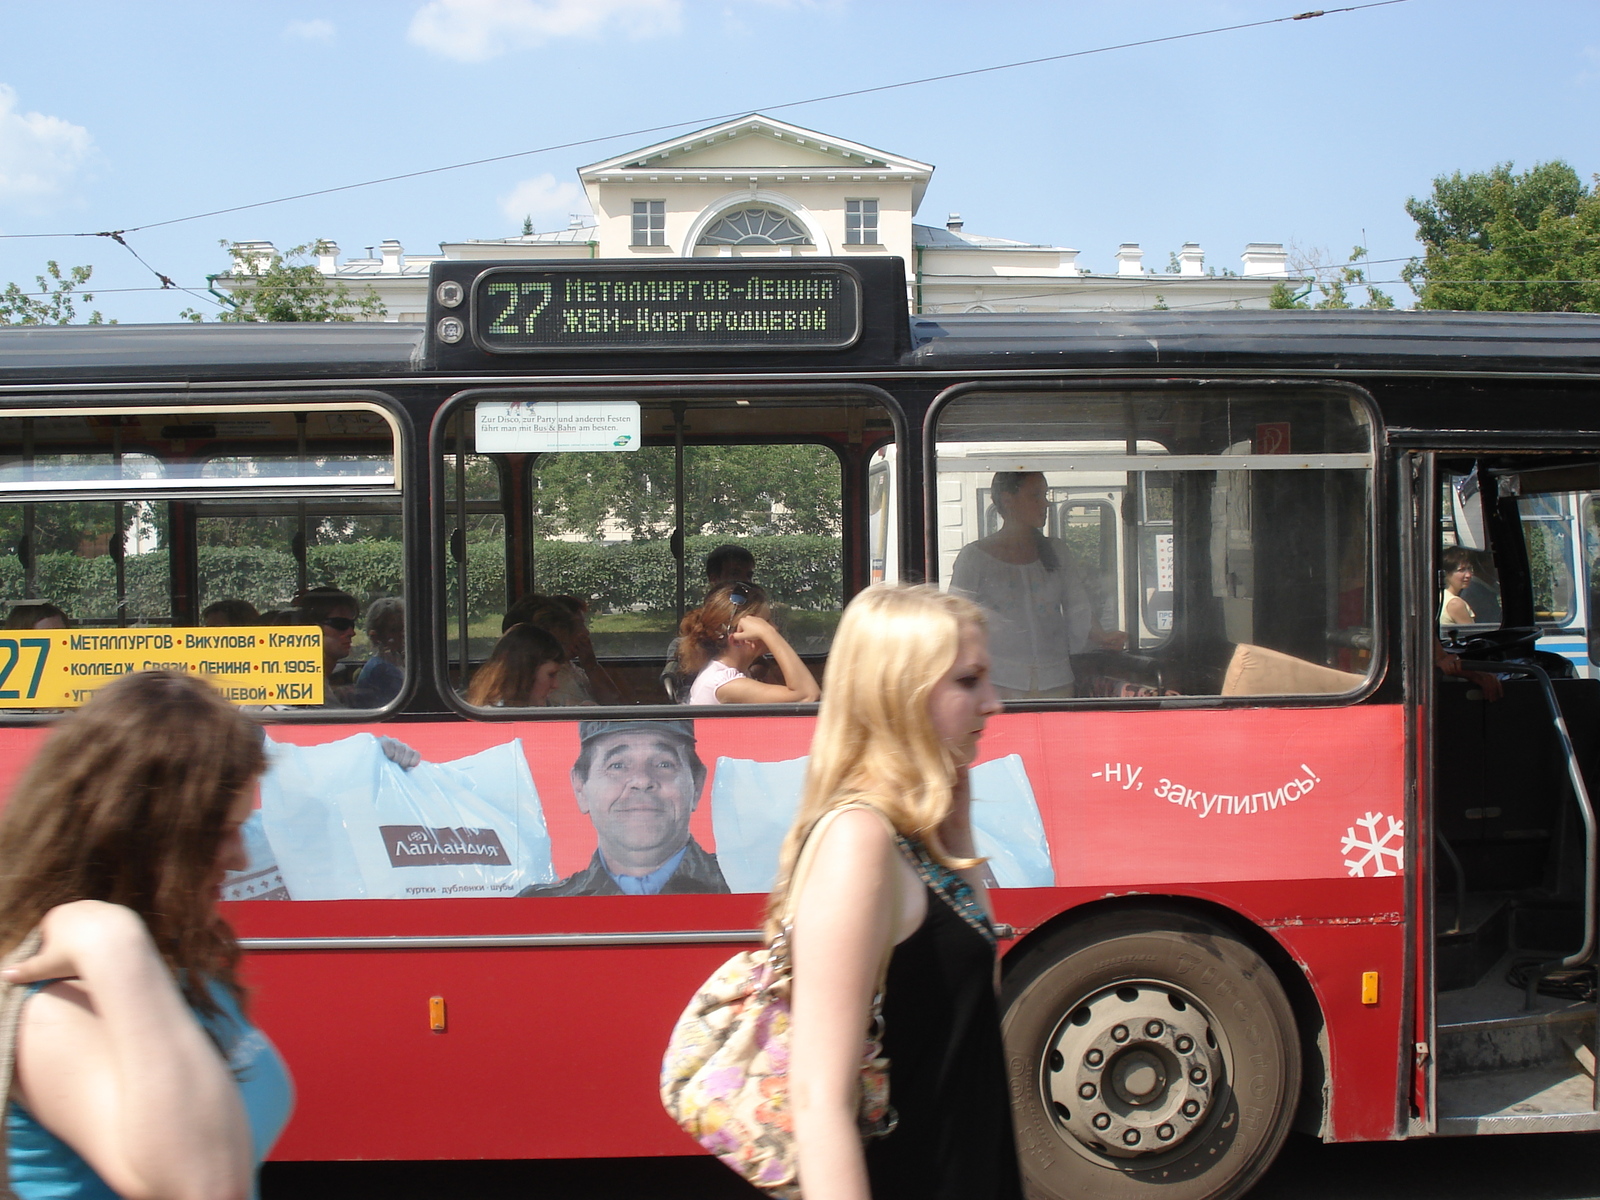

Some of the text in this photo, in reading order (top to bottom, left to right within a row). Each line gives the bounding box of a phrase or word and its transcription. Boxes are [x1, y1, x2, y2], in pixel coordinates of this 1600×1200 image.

[488, 281, 552, 335] 27
[481, 415, 496, 424] Zur
[497, 415, 521, 425] Disco,
[536, 415, 556, 425] Party
[558, 415, 573, 423] und
[575, 415, 606, 423] anderen
[607, 415, 631, 423] Festen
[481, 424, 499, 432] fährt
[519, 424, 532, 432] mit
[533, 424, 548, 432] Bus
[548, 424, 556, 432] &
[557, 424, 577, 432] Bahn
[592, 424, 618, 432] besten.
[1161, 618, 1168, 627] 7
[0, 638, 51, 699] 27
[71, 662, 135, 676] КОЛЛЕДЖ
[275, 683, 313, 700] ЖБИ
[1091, 762, 1322, 819] -ну, закупились!
[395, 841, 499, 857] Лапландия
[405, 883, 515, 895] куртки дубленки шубы
